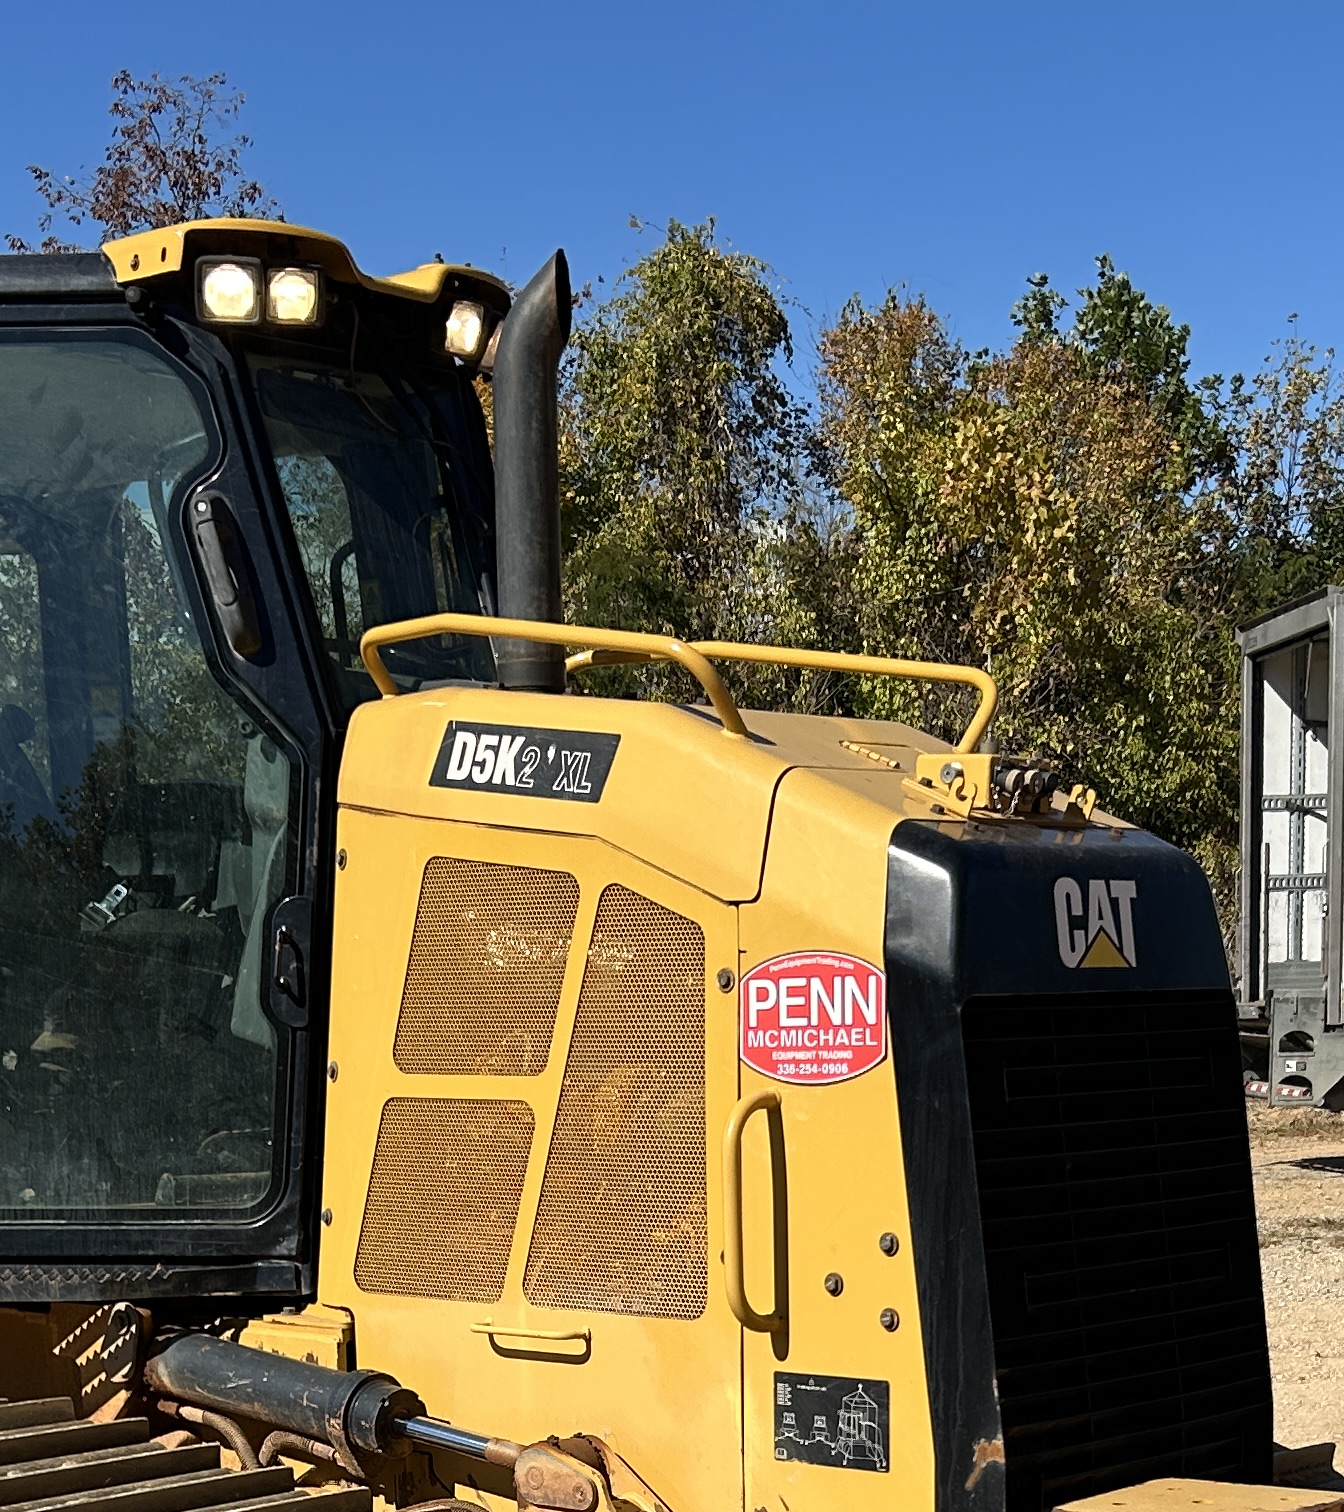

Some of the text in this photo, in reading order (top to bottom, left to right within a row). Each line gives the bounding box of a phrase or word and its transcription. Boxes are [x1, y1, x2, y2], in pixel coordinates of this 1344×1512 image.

[446, 731, 541, 788] D5K2
[1053, 876, 1138, 969] CAT
[747, 974, 878, 1028] PENN
[747, 1027, 878, 1048] MCMICHAEL
[771, 1050, 854, 1061] EQUIPMENT TRADING
